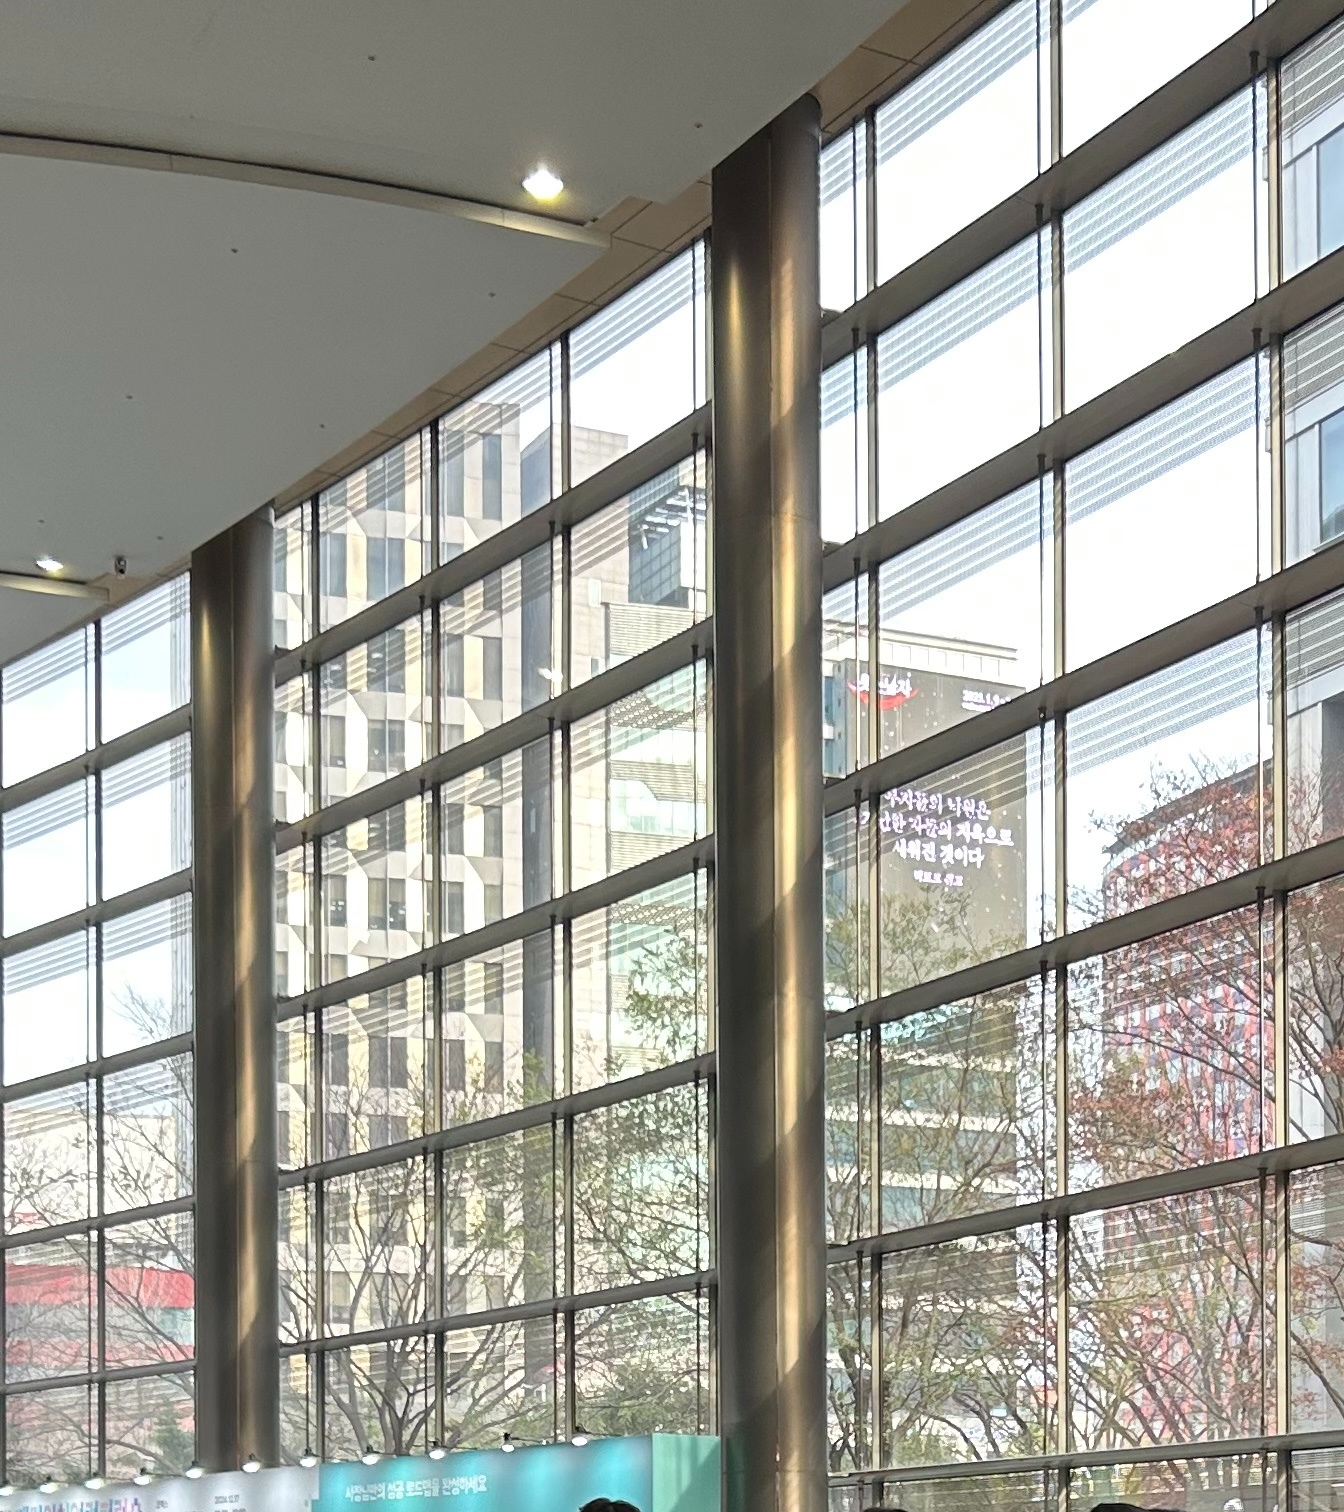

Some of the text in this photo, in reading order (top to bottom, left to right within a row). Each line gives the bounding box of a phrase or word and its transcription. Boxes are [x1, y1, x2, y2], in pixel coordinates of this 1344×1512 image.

[940, 843, 986, 869] 것이다
[387, 1480, 405, 1499] 성공
[442, 1474, 488, 1495] 완성하세요
